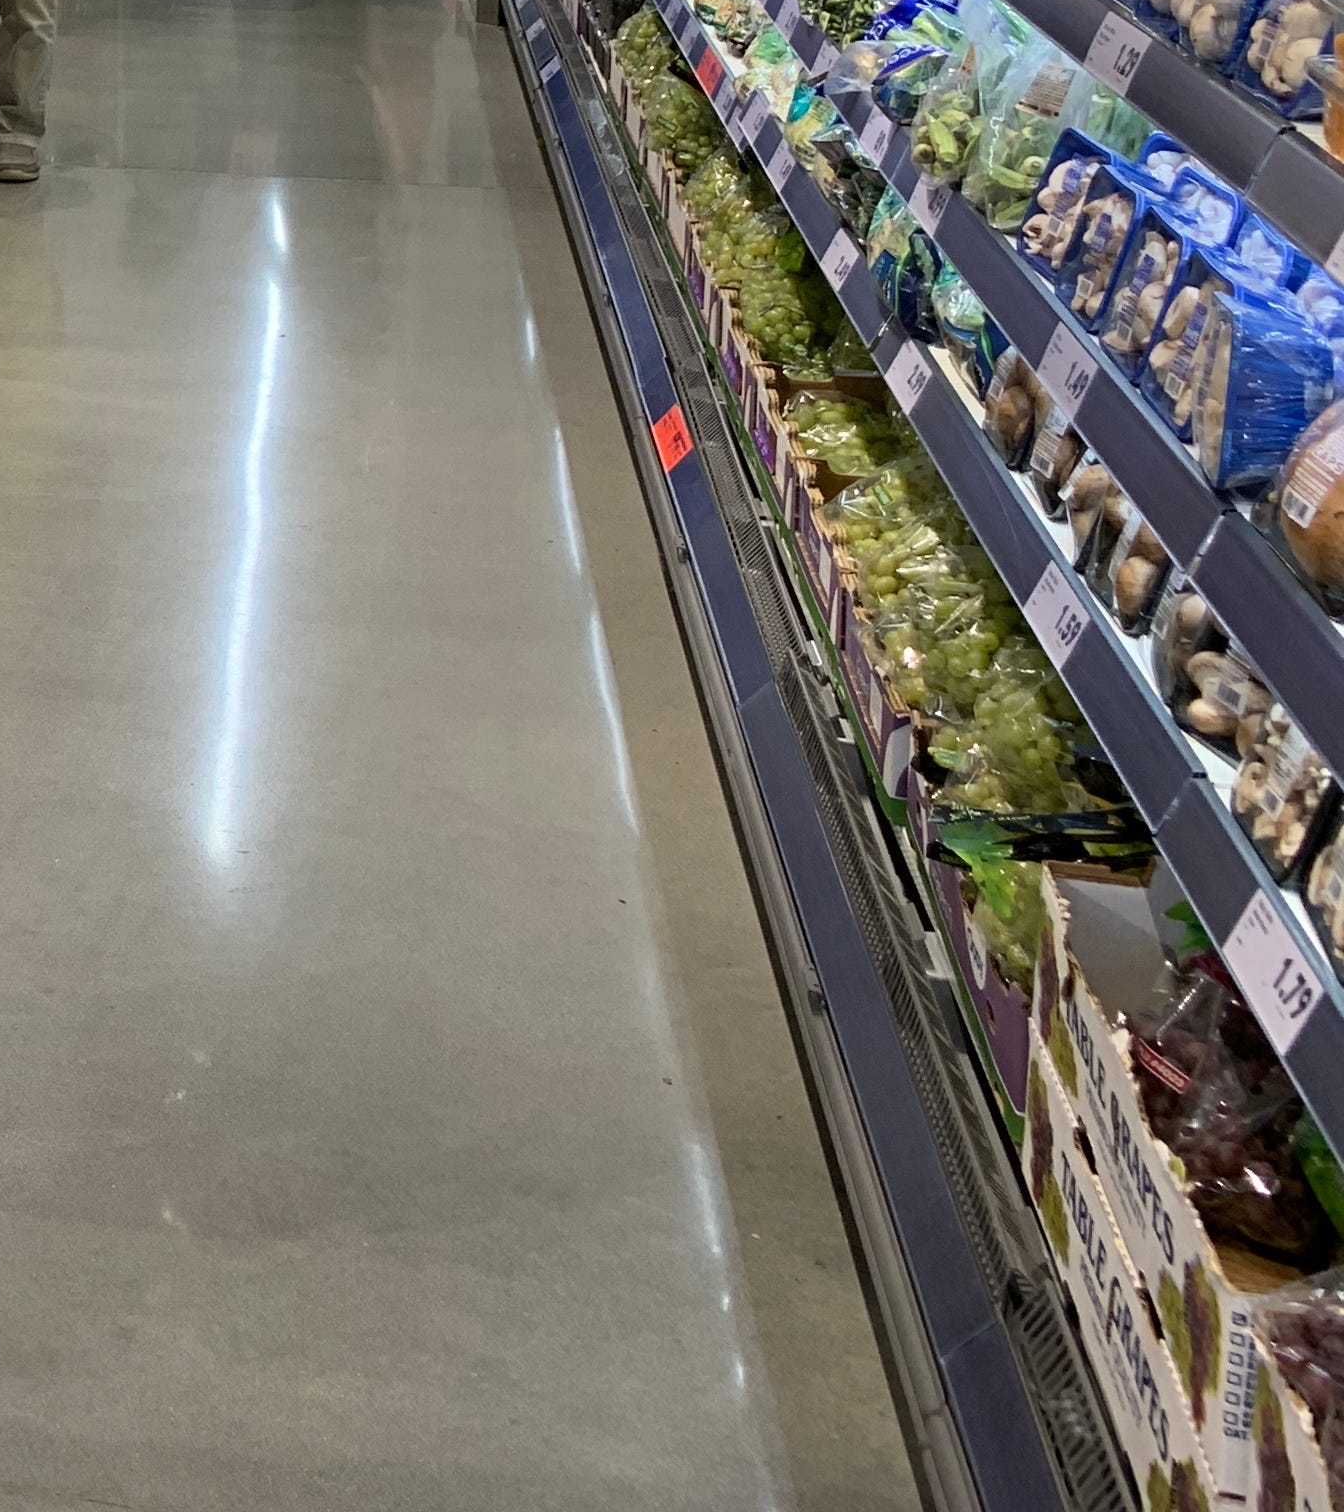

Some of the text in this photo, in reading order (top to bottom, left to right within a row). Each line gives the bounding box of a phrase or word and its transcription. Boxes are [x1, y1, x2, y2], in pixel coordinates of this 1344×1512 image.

[1113, 44, 1141, 78] 1.29
[1062, 360, 1090, 400] 1.49
[1055, 605, 1082, 646] 1.59
[1274, 957, 1313, 1019] 1.79
[1065, 996, 1108, 1110] TABLE
[1111, 1090, 1176, 1267] GRAPES
[1062, 1150, 1171, 1462] TABLE GRAPES
